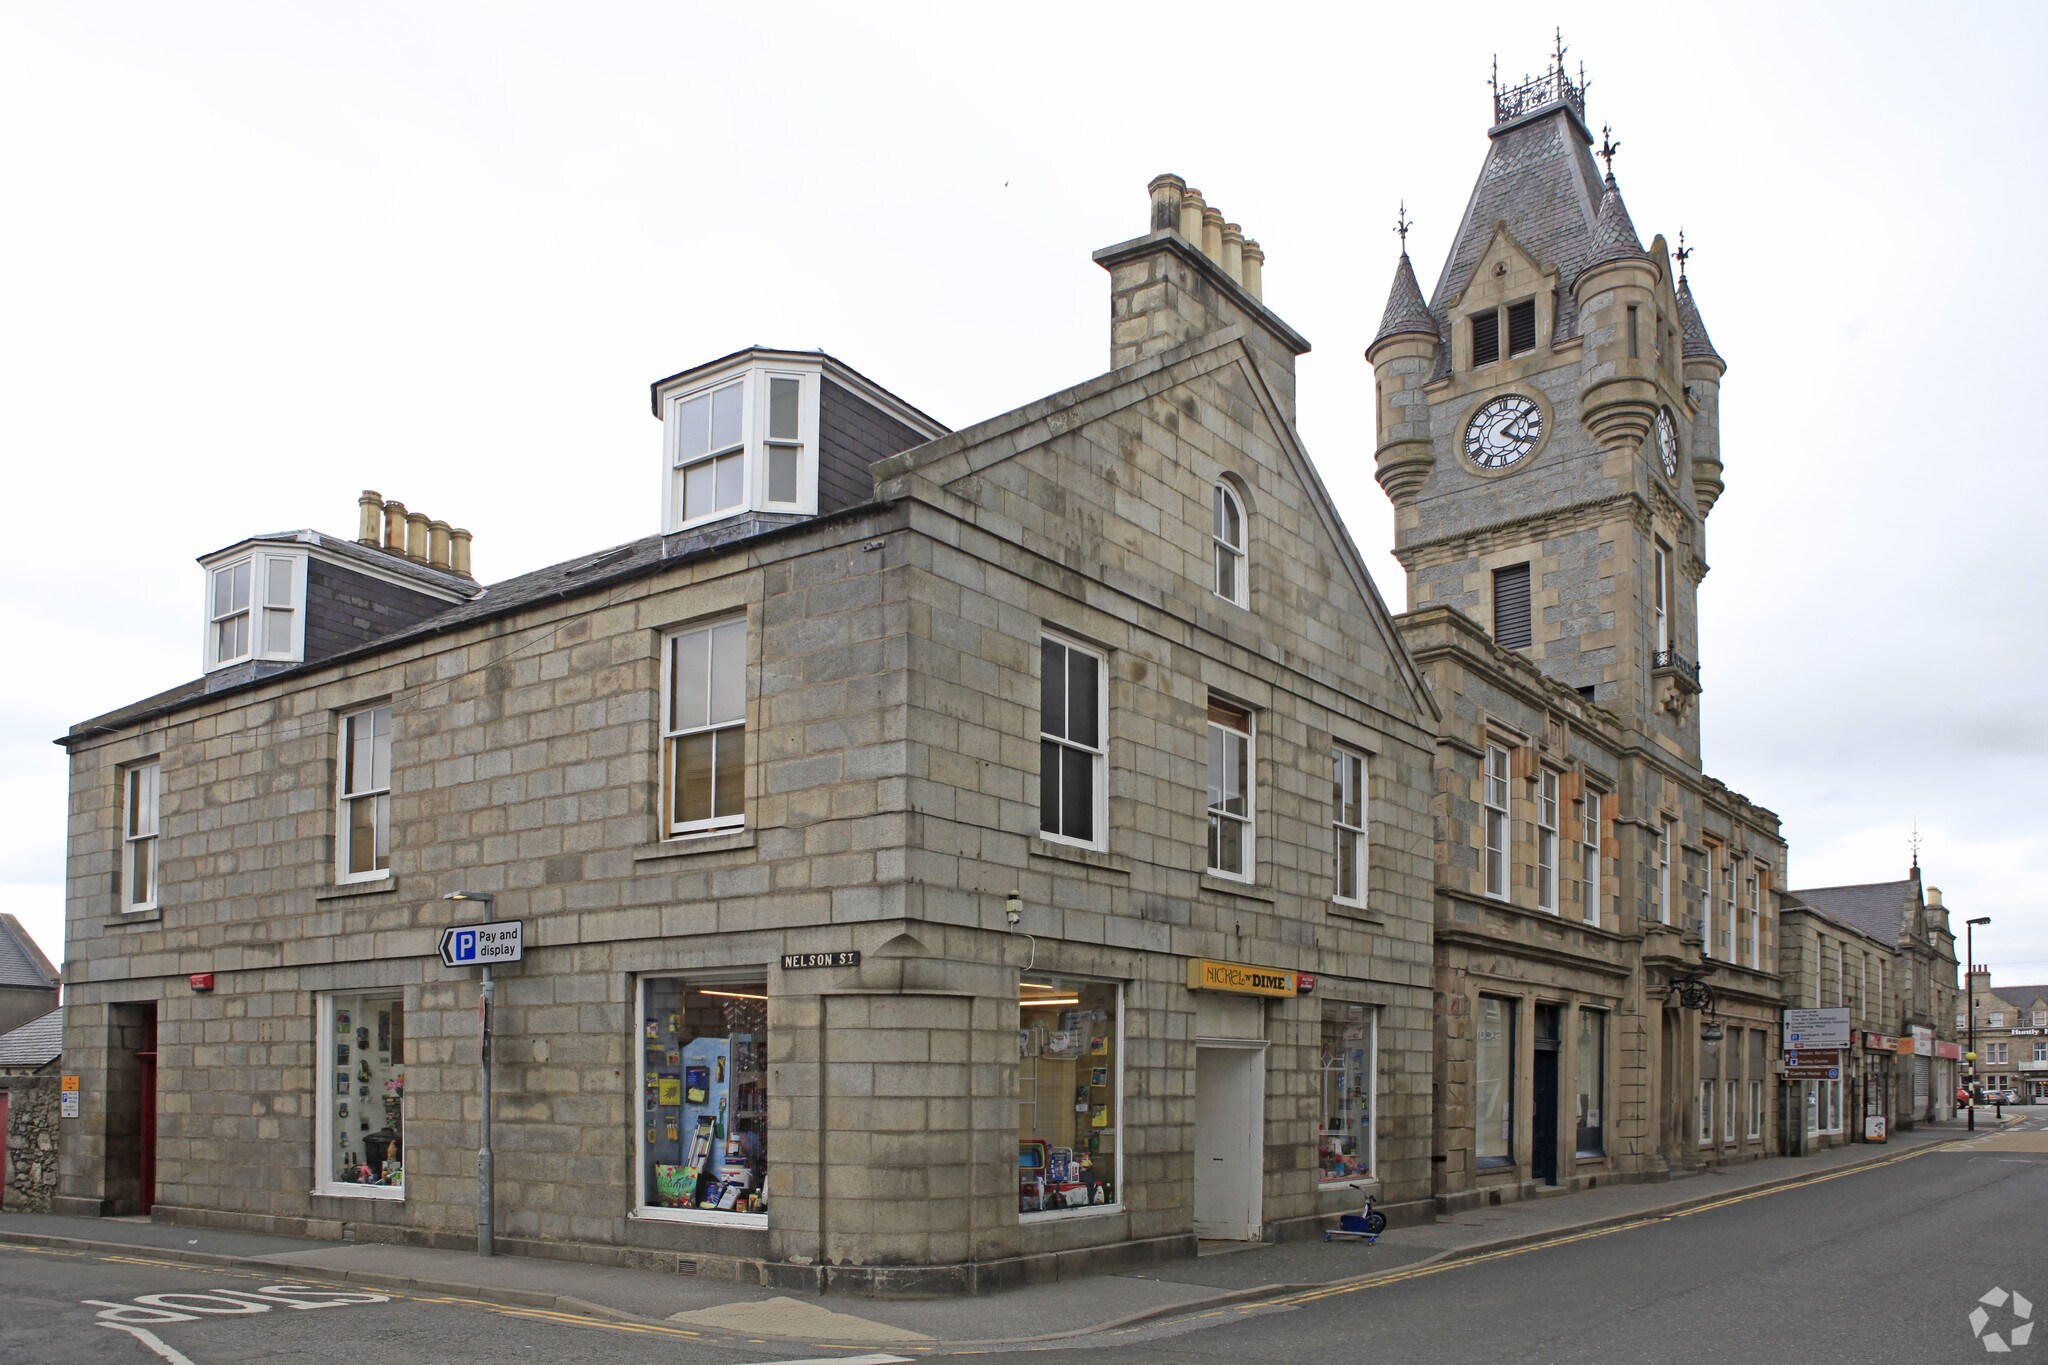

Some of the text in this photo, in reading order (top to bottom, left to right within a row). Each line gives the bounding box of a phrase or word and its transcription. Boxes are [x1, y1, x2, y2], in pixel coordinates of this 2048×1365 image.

[479, 928, 517, 943] Pay and
[480, 944, 515, 957] display
[785, 953, 832, 967] NELSON
[1206, 966, 1245, 986] NICKEL
[1252, 974, 1285, 990] DIME
[81, 1285, 390, 1323] STOP
